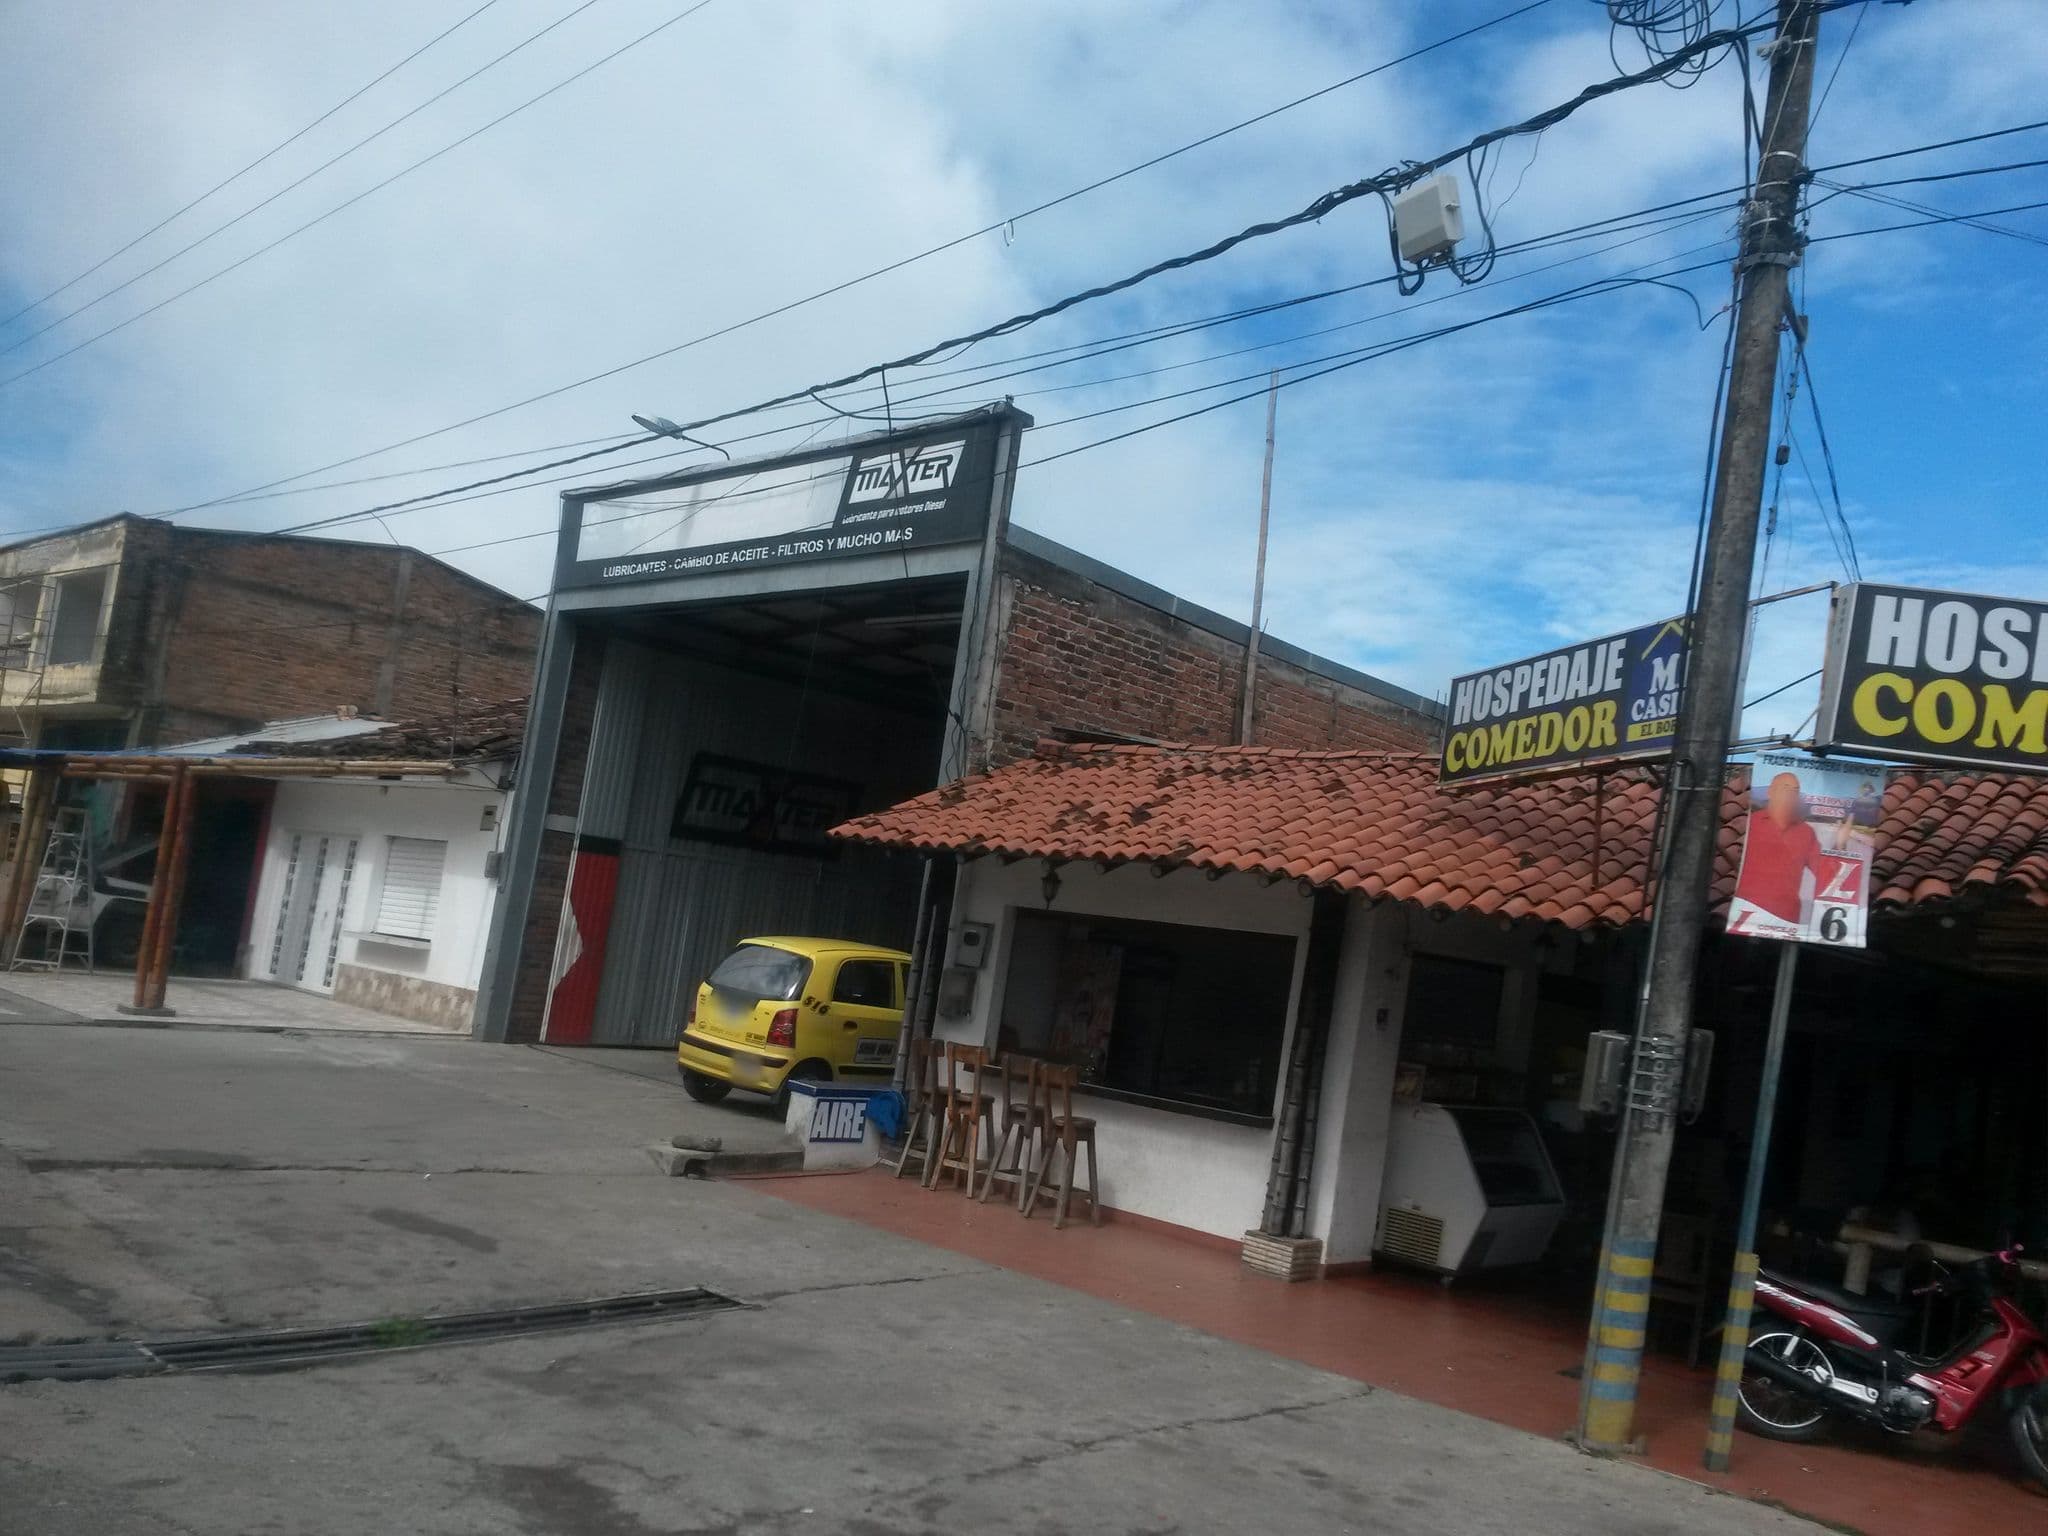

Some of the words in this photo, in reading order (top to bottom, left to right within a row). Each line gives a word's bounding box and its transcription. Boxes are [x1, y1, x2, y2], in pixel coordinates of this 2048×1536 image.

[857, 444, 954, 500] MAXTER
[877, 506, 895, 522] para
[924, 498, 948, 511] Diesel
[603, 560, 667, 578] LUBRICANTES
[673, 554, 713, 570] CAMBIO
[714, 552, 730, 565] DE
[730, 546, 769, 563] ACEITE
[777, 539, 824, 557] FILTROS
[826, 538, 835, 551] Y
[836, 531, 882, 550] MUCHO
[885, 527, 913, 543] MAS
[1453, 638, 1627, 726] HOSPEDAJE
[1446, 700, 1618, 773] COMEDOR
[1640, 723, 1653, 737] EL
[1820, 906, 1848, 942] 6
[810, 1101, 867, 1139] AIRE
